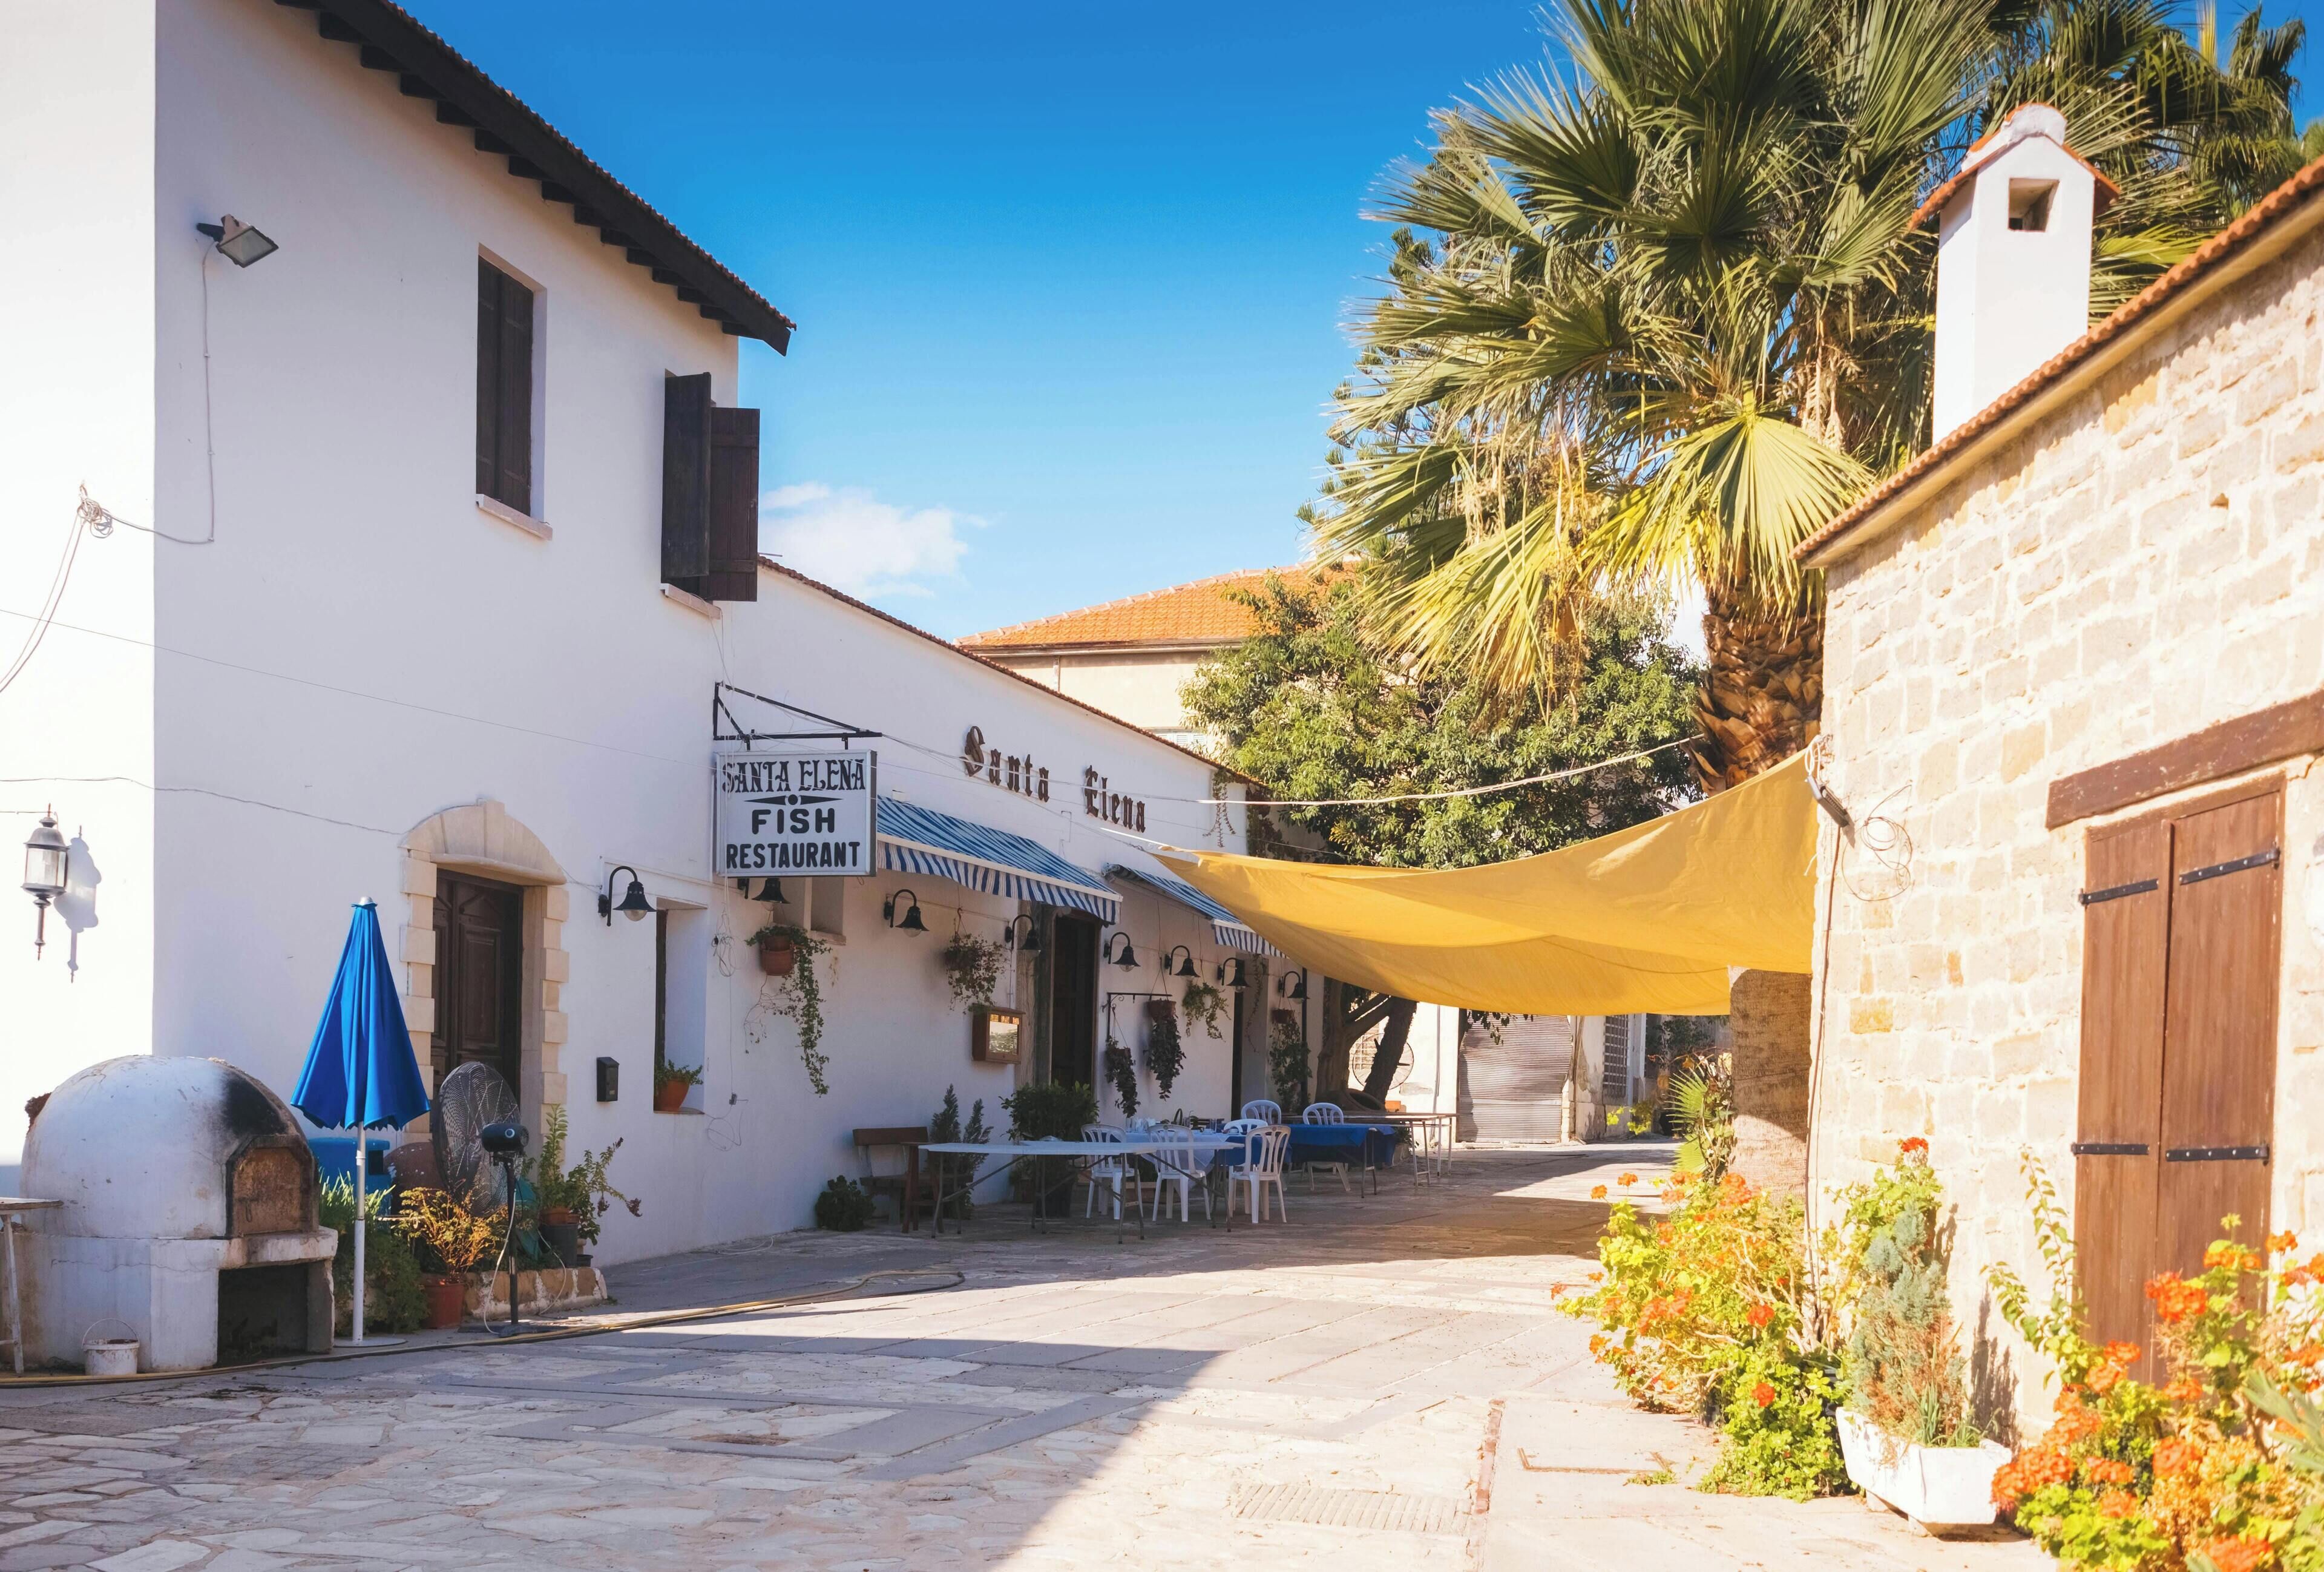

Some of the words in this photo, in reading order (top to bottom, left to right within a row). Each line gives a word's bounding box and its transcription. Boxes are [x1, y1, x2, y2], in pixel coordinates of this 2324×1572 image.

[722, 761, 791, 794] SANTA
[798, 758, 866, 792] ELENA
[959, 726, 1050, 803] Santa
[1084, 765, 1146, 833] Elena
[752, 808, 835, 835] FISH
[726, 841, 860, 869] RESTAURANT
